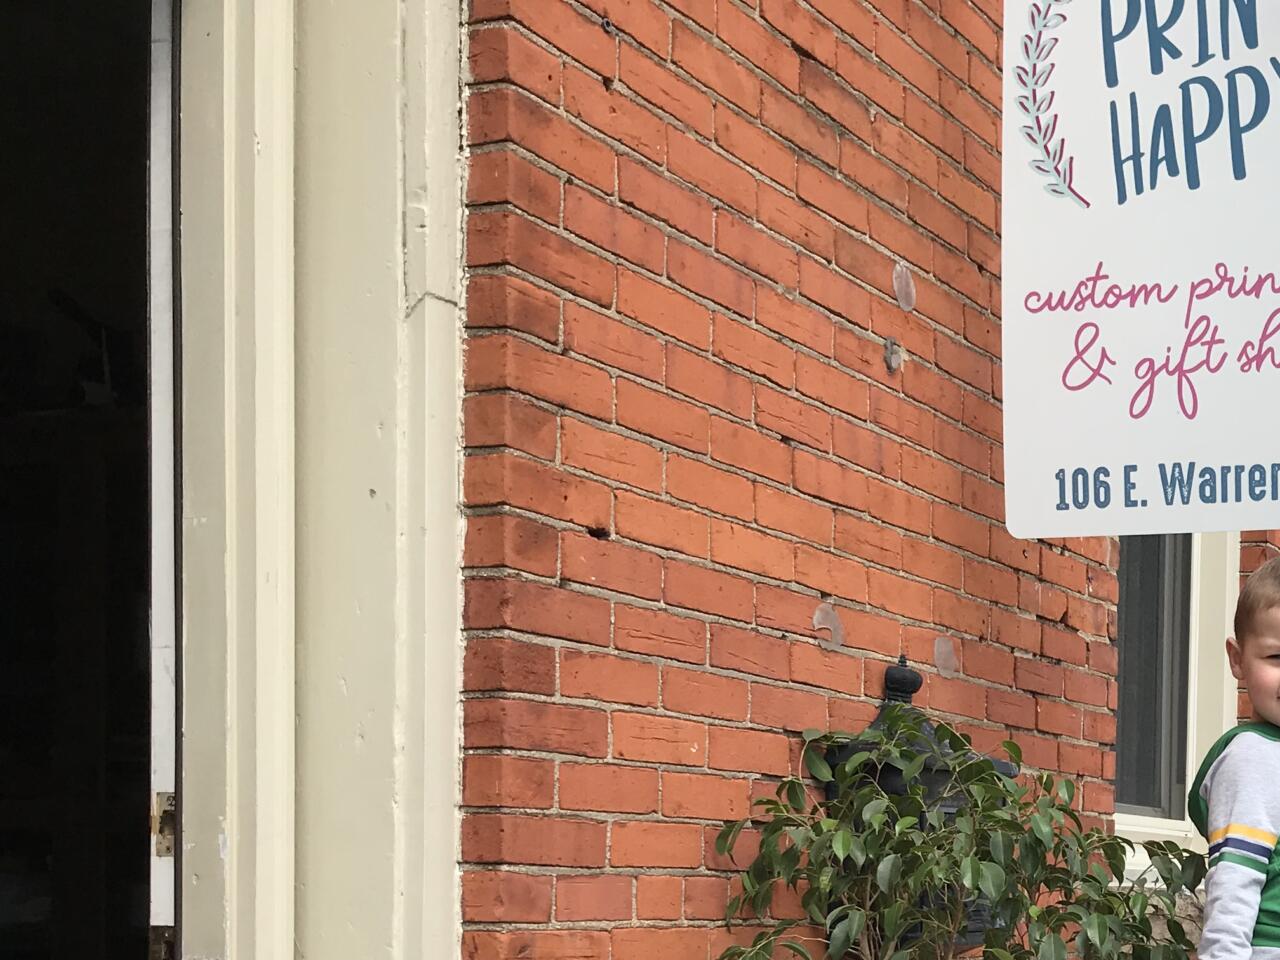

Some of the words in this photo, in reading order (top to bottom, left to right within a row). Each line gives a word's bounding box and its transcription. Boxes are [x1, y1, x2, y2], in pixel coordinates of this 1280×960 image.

[1023, 261, 1179, 314] custom
[1061, 321, 1117, 392] &
[1128, 314, 1229, 420] gift
[1055, 467, 1110, 511] 106
[1124, 464, 1148, 508] E.
